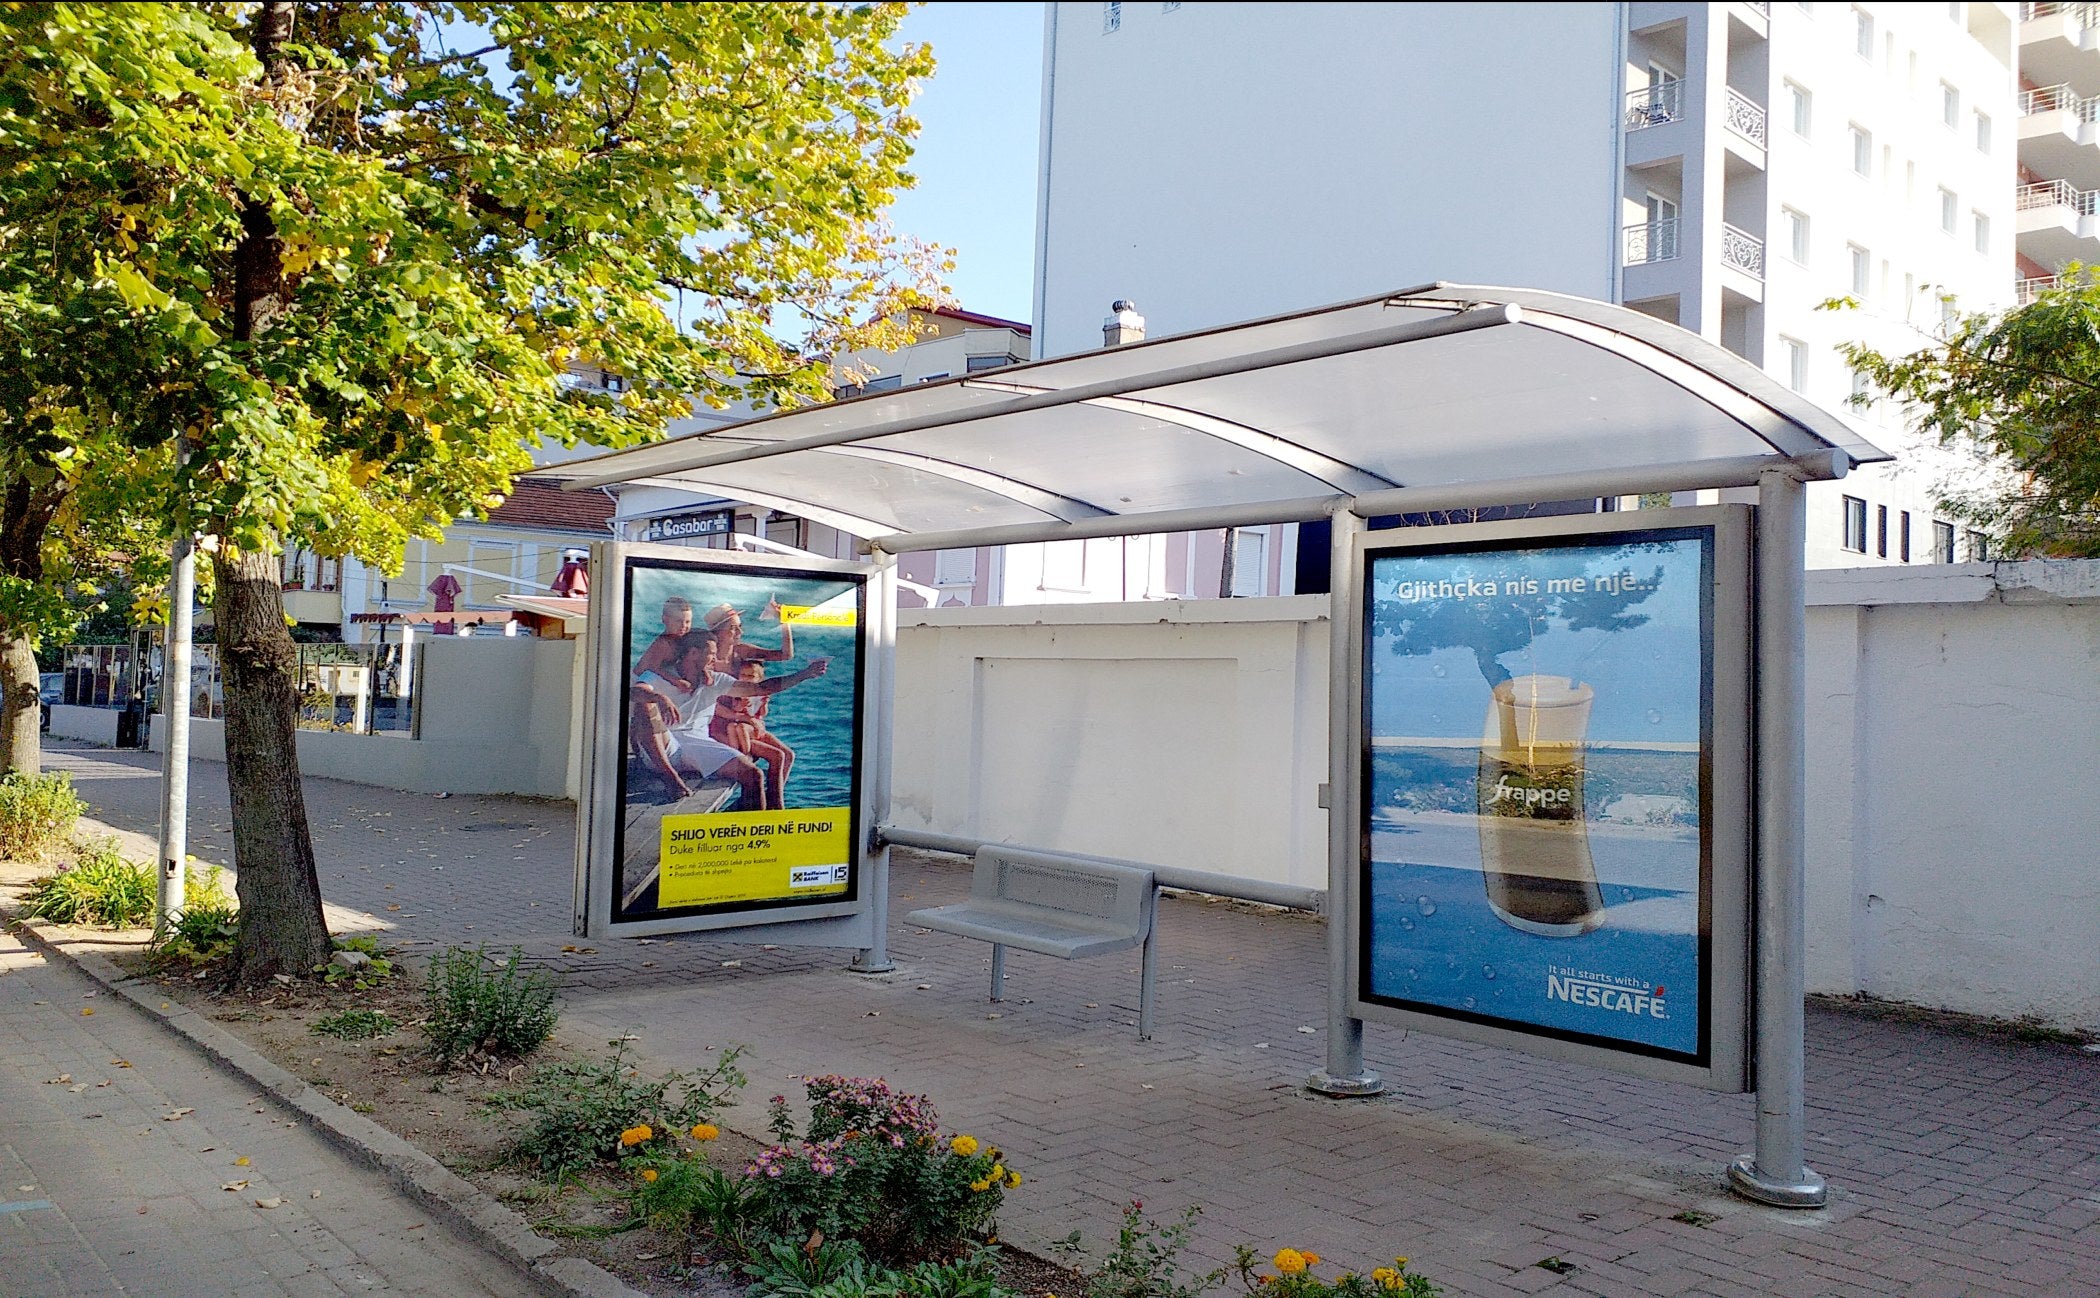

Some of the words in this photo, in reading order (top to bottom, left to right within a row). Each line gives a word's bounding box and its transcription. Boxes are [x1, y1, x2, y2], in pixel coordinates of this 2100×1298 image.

[663, 518, 713, 537] Casabar
[1398, 578, 1498, 603] Gjithçka
[1505, 576, 1538, 596] nis
[1547, 577, 1586, 594] me
[1485, 775, 1571, 808] frappe
[671, 828, 706, 841] SHIJO
[709, 824, 747, 839] VERËN
[750, 825, 775, 836] DERI
[778, 821, 794, 834] NË
[797, 822, 833, 834] FUND!
[670, 844, 694, 855] Duke
[697, 842, 722, 852] filluar
[726, 844, 744, 853] nga
[747, 839, 771, 849] 4.9%
[1548, 964, 1557, 974] It
[1560, 967, 1576, 977] all
[1578, 970, 1612, 983] starts
[1614, 976, 1640, 987] with
[1642, 981, 1650, 989] a
